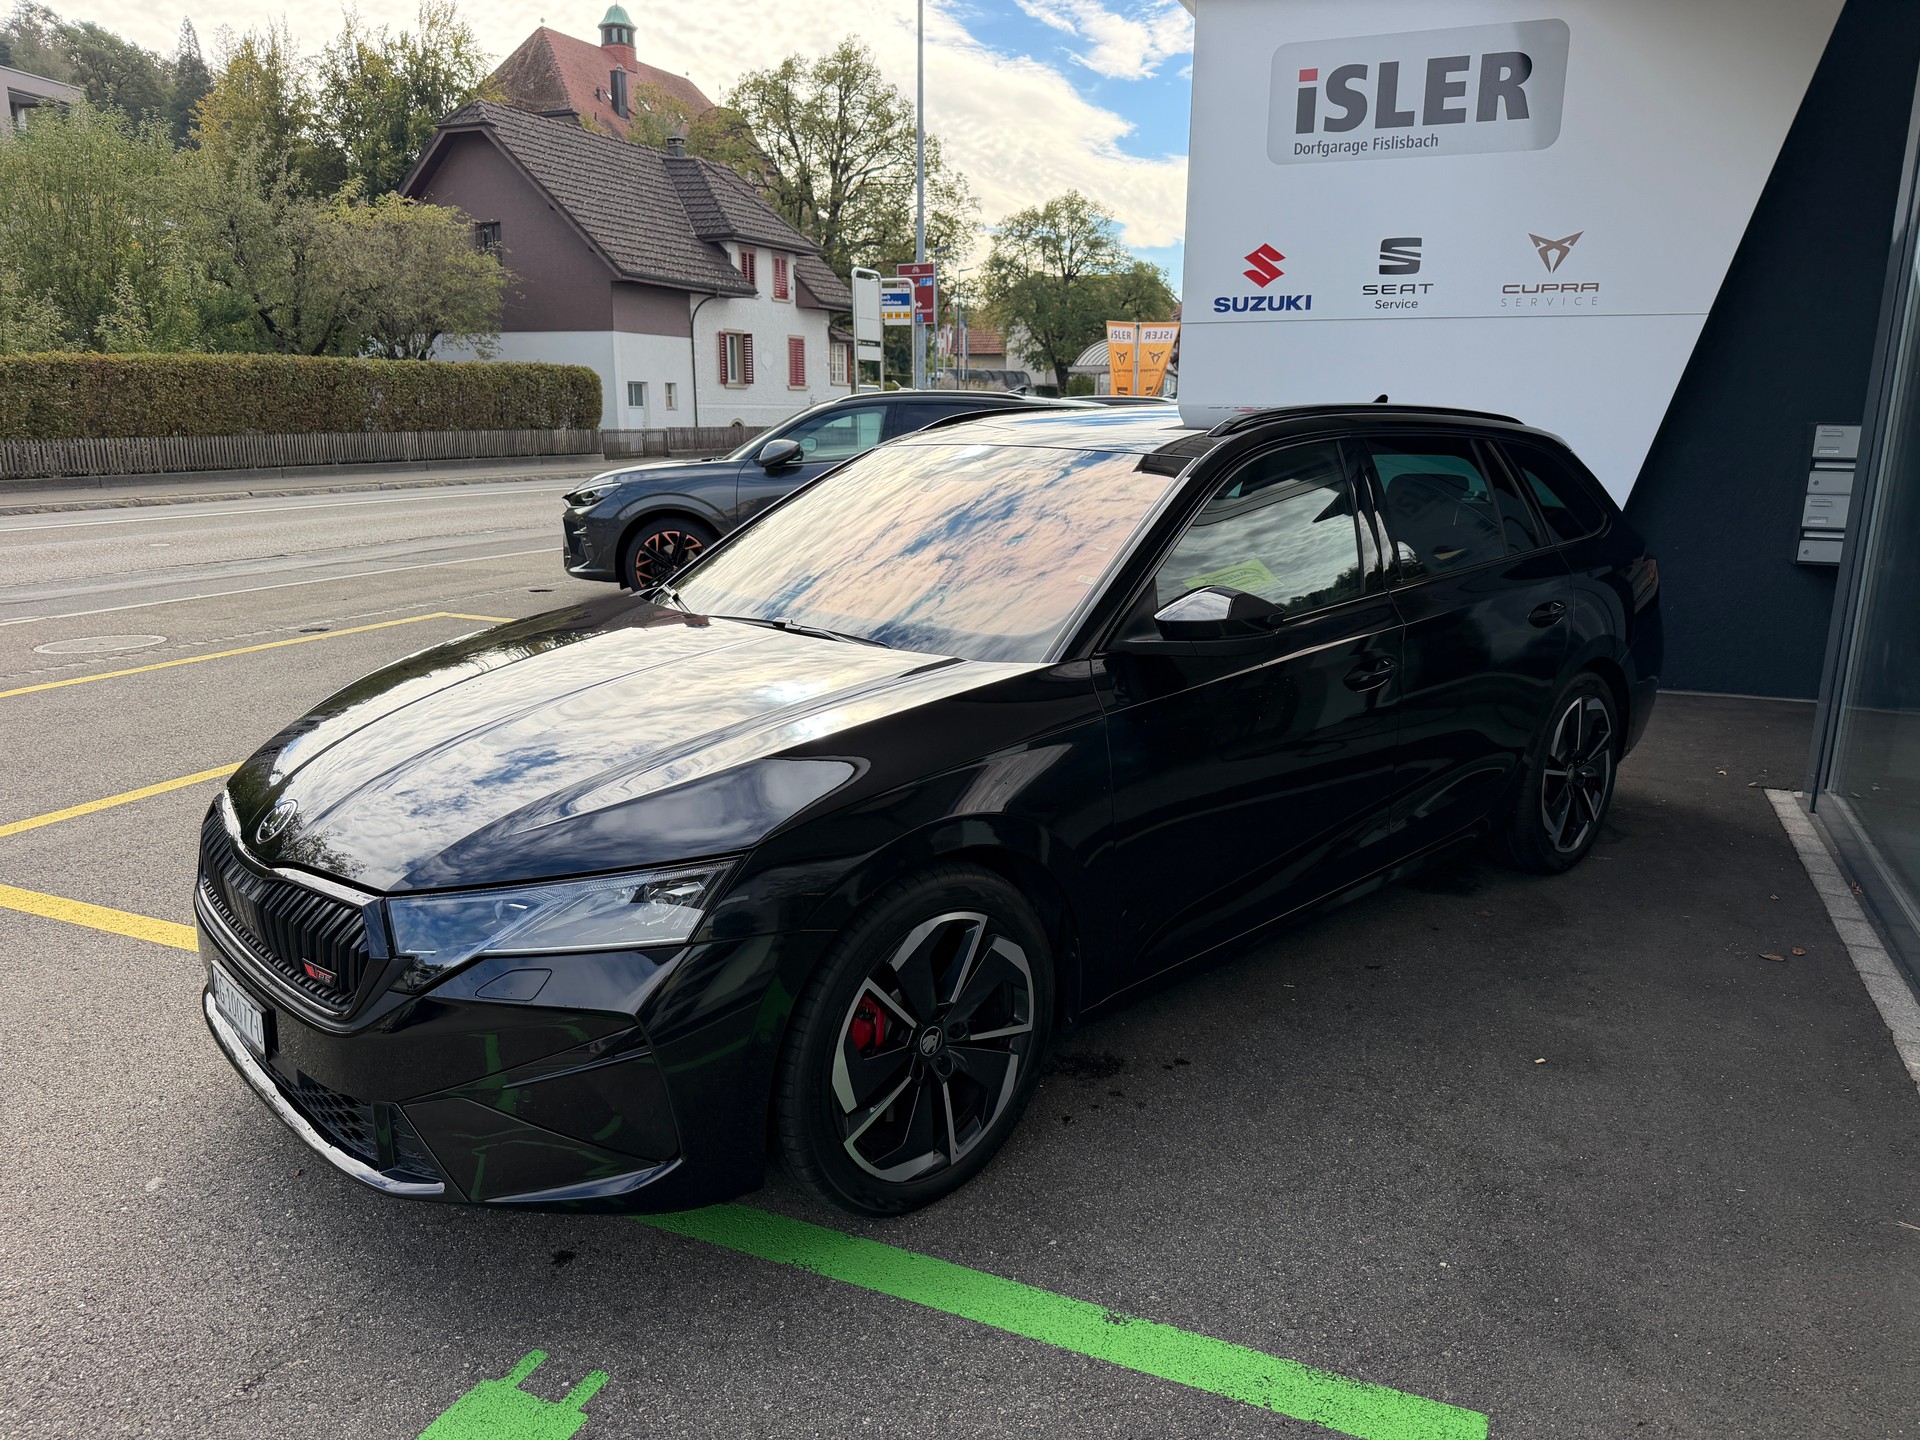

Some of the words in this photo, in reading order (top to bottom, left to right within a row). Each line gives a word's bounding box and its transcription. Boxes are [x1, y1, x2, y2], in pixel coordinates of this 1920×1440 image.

[1294, 141, 1368, 157] Dorfgarage
[1372, 133, 1439, 150] Fislisbach
[1362, 283, 1434, 295] SEAT
[1502, 283, 1600, 294] CUPRA
[1213, 294, 1312, 313] SUZUKI
[1374, 299, 1419, 310] Service
[1501, 296, 1598, 308] SERVICE
